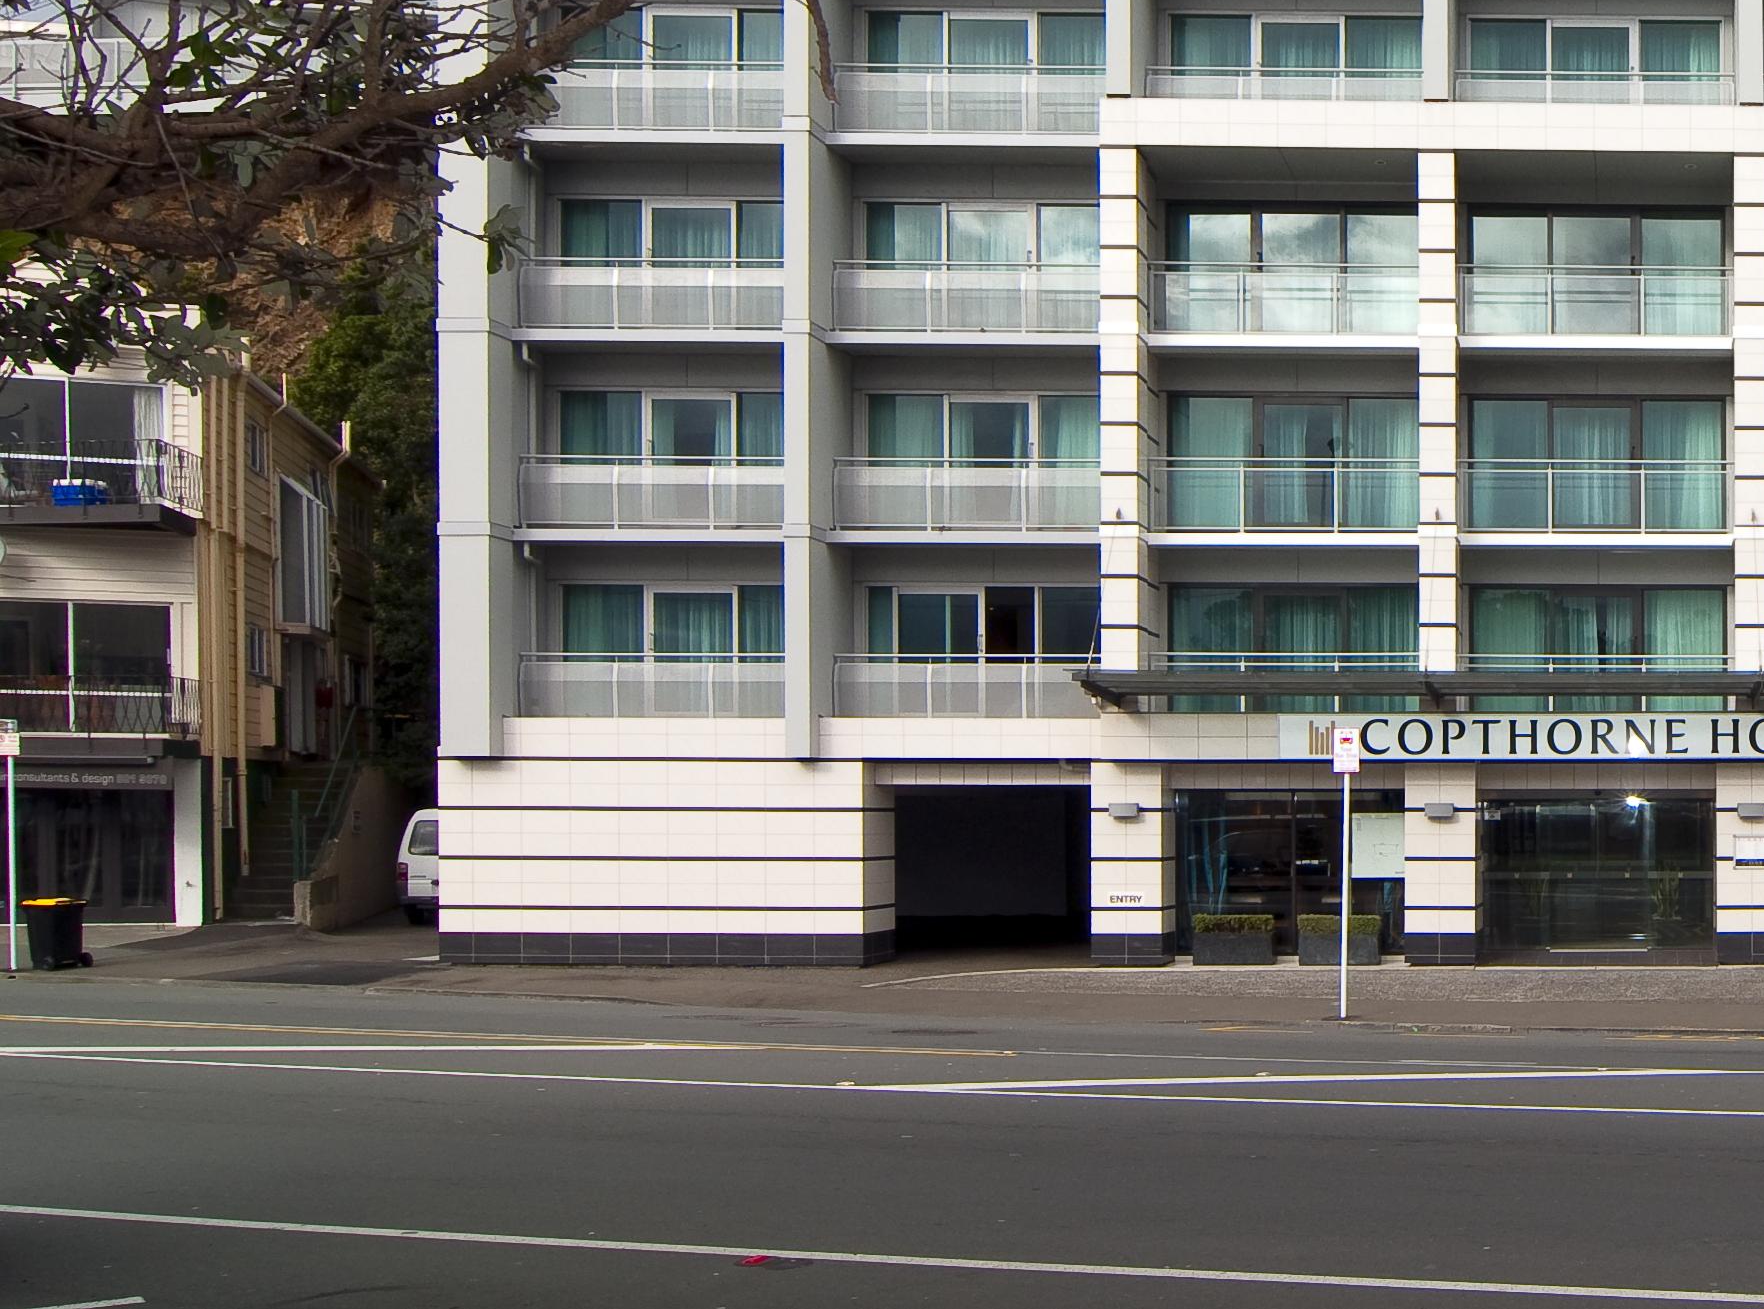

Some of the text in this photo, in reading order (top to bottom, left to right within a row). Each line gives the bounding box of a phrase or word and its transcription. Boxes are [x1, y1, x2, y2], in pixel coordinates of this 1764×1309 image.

[1360, 718, 1688, 754] COPTHORNE
[71, 773, 79, 783] &
[82, 773, 114, 786] design
[1110, 895, 1142, 903] ENTRY
